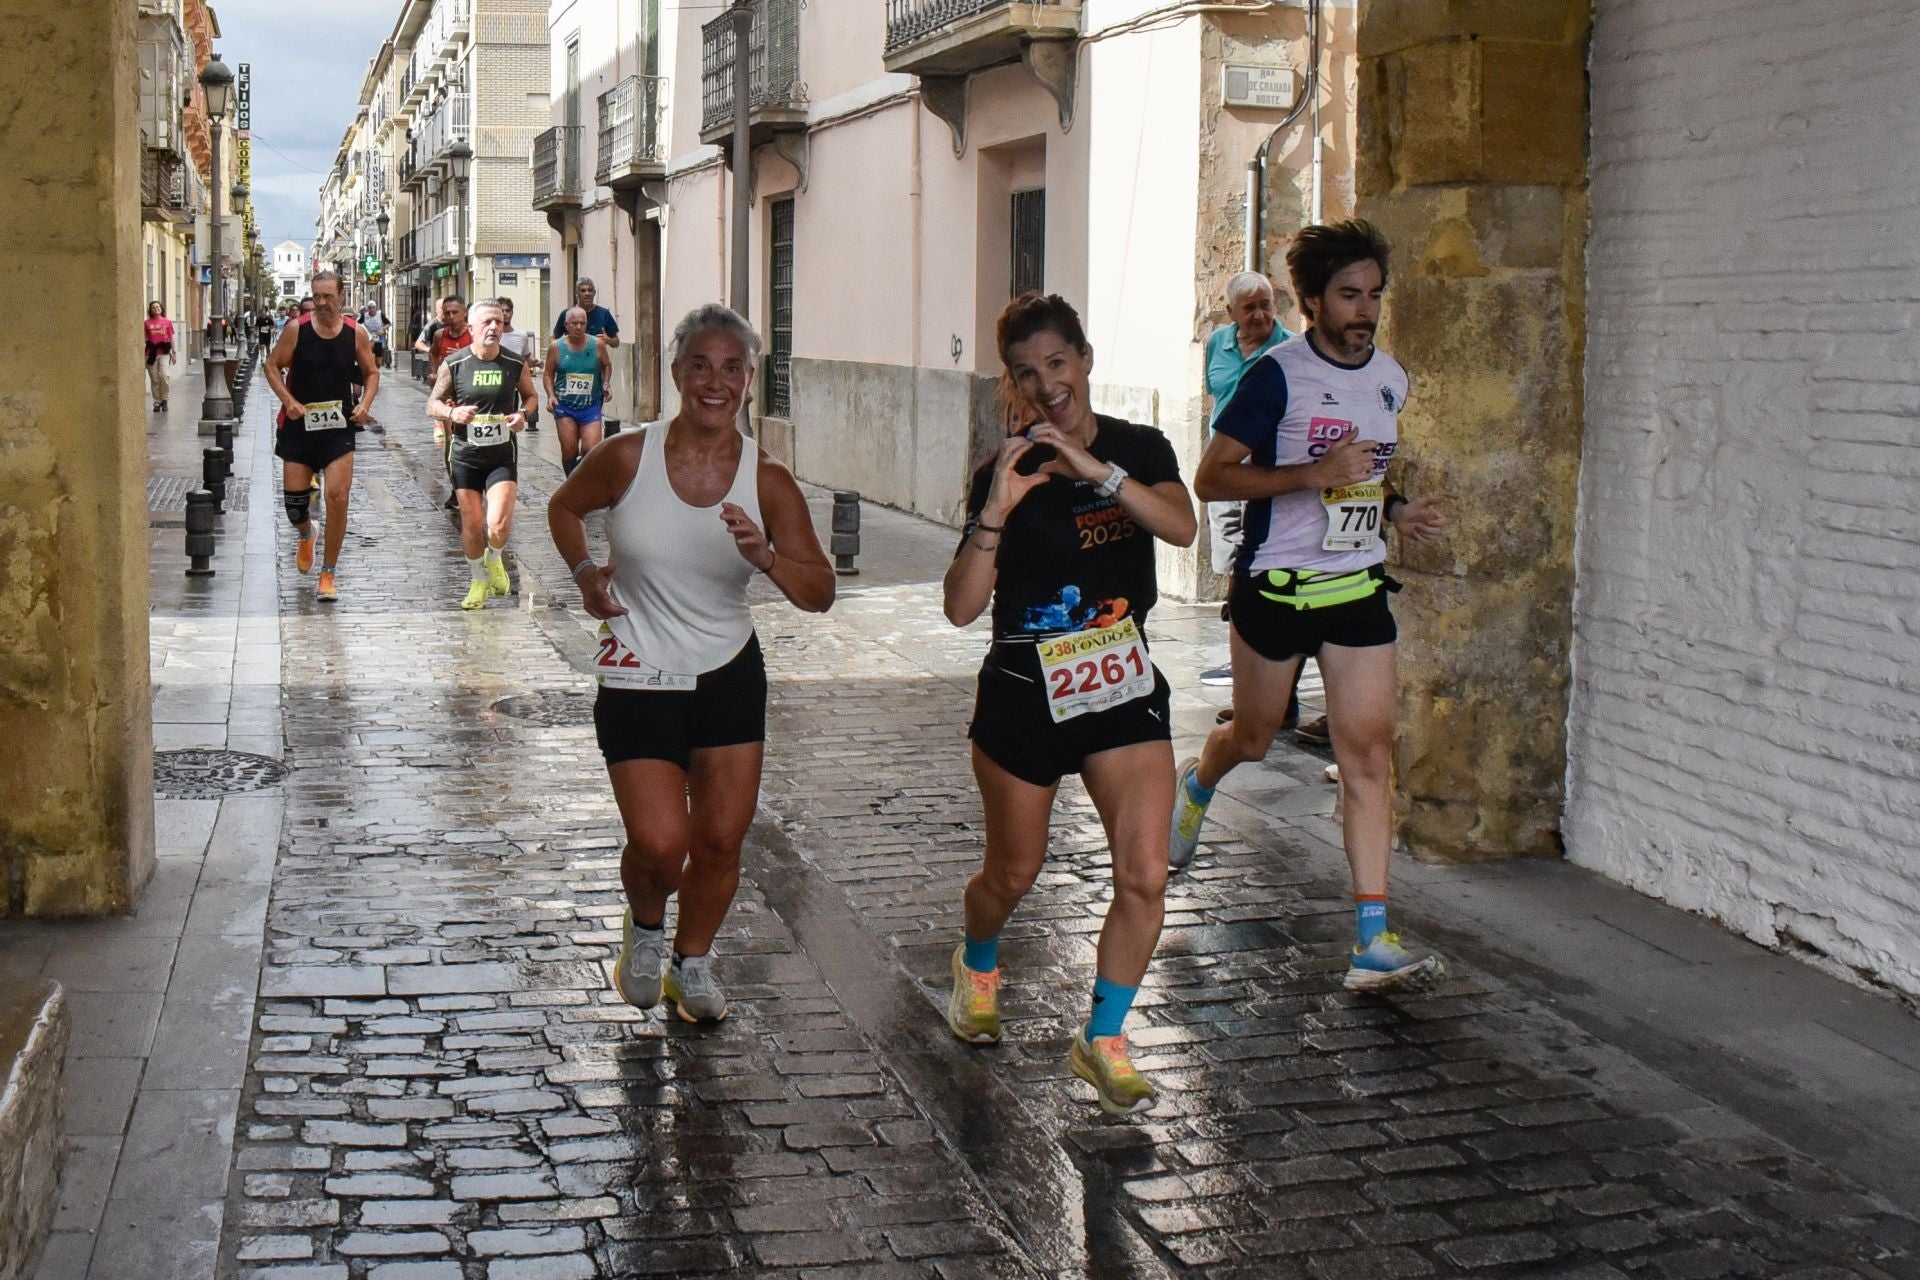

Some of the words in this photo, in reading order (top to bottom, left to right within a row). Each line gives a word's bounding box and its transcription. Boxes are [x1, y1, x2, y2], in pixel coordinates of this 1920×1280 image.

[1248, 81, 1258, 91] DE
[239, 64, 249, 129] TEJIDOS
[1256, 94, 1280, 105] NORTE
[472, 374, 502, 387] RUN
[570, 380, 590, 390] 762
[310, 411, 340, 423] 314
[473, 423, 502, 438] 821
[1340, 505, 1377, 533] 770
[1079, 518, 1135, 550] 2025
[1054, 641, 1073, 657] 38
[1072, 631, 1123, 654] FONDO
[1050, 646, 1144, 700] 2261
